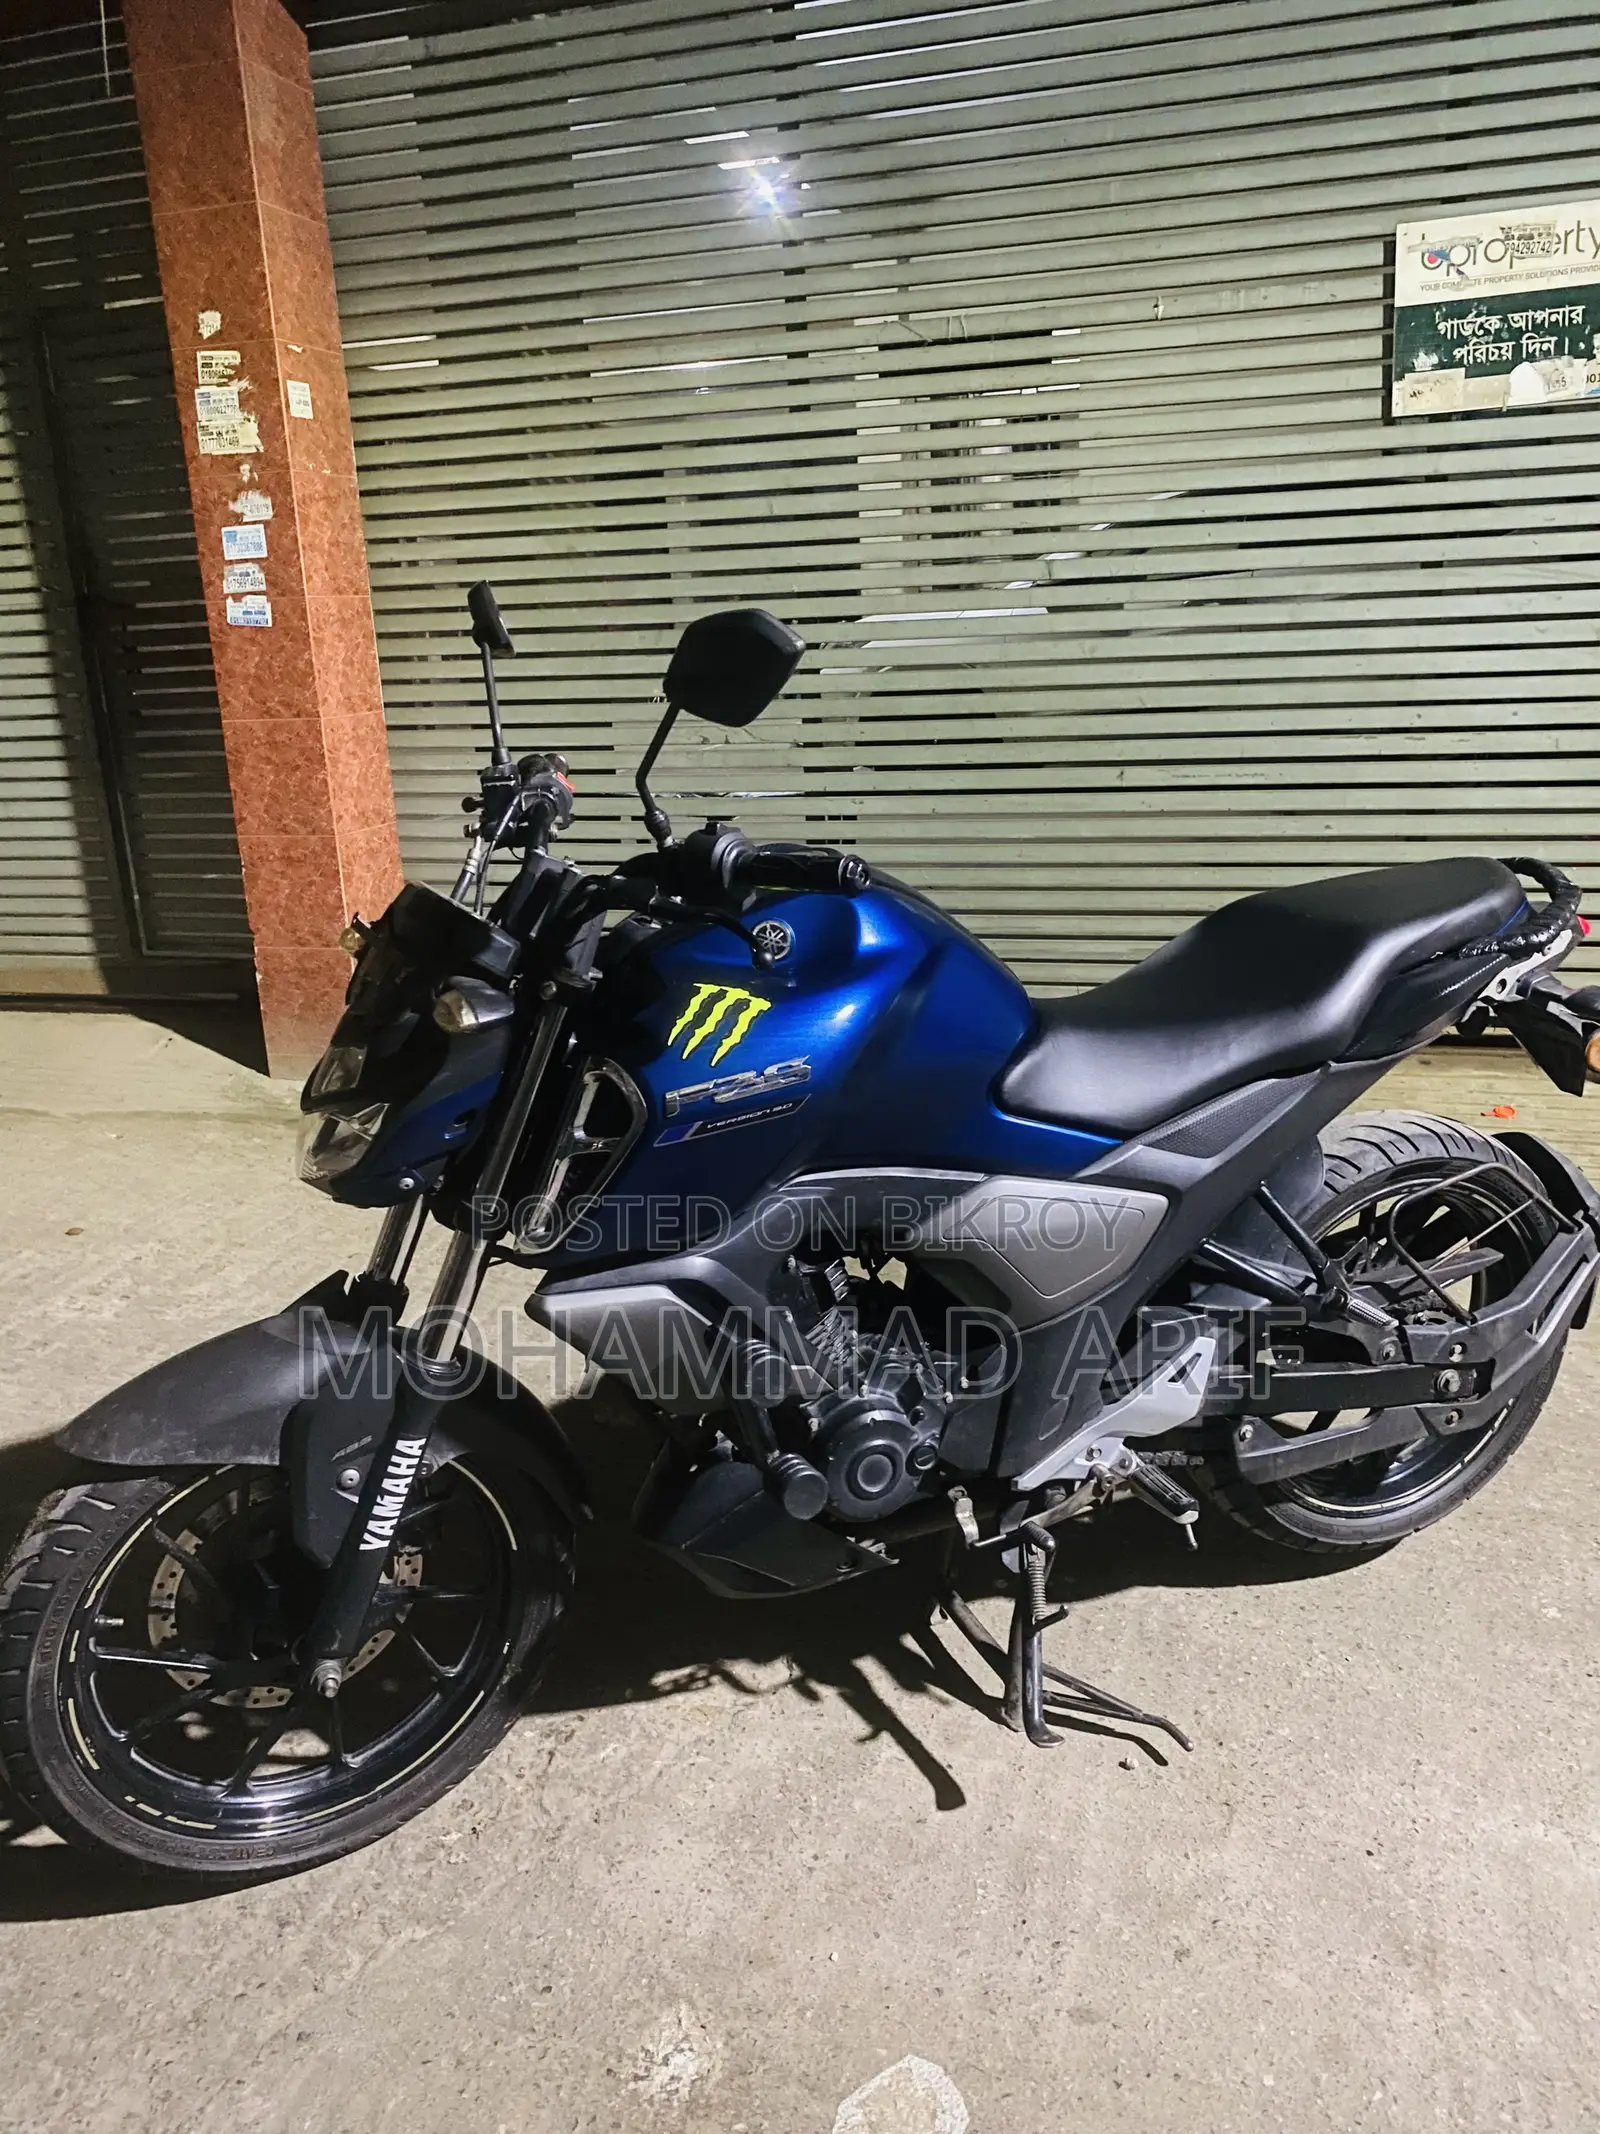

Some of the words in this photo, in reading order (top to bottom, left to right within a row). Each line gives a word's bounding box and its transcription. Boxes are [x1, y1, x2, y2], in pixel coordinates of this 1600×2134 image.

[1420, 282, 1441, 292] YOUR
[1484, 272, 1524, 286] PROPERTY
[1525, 267, 1568, 280] SOLUTIONS
[1570, 263, 1600, 275] PROVID
[1507, 305, 1586, 331] আপনার
[1452, 337, 1516, 366] পরিচয়
[359, 1438, 427, 1551] YAMAHA
